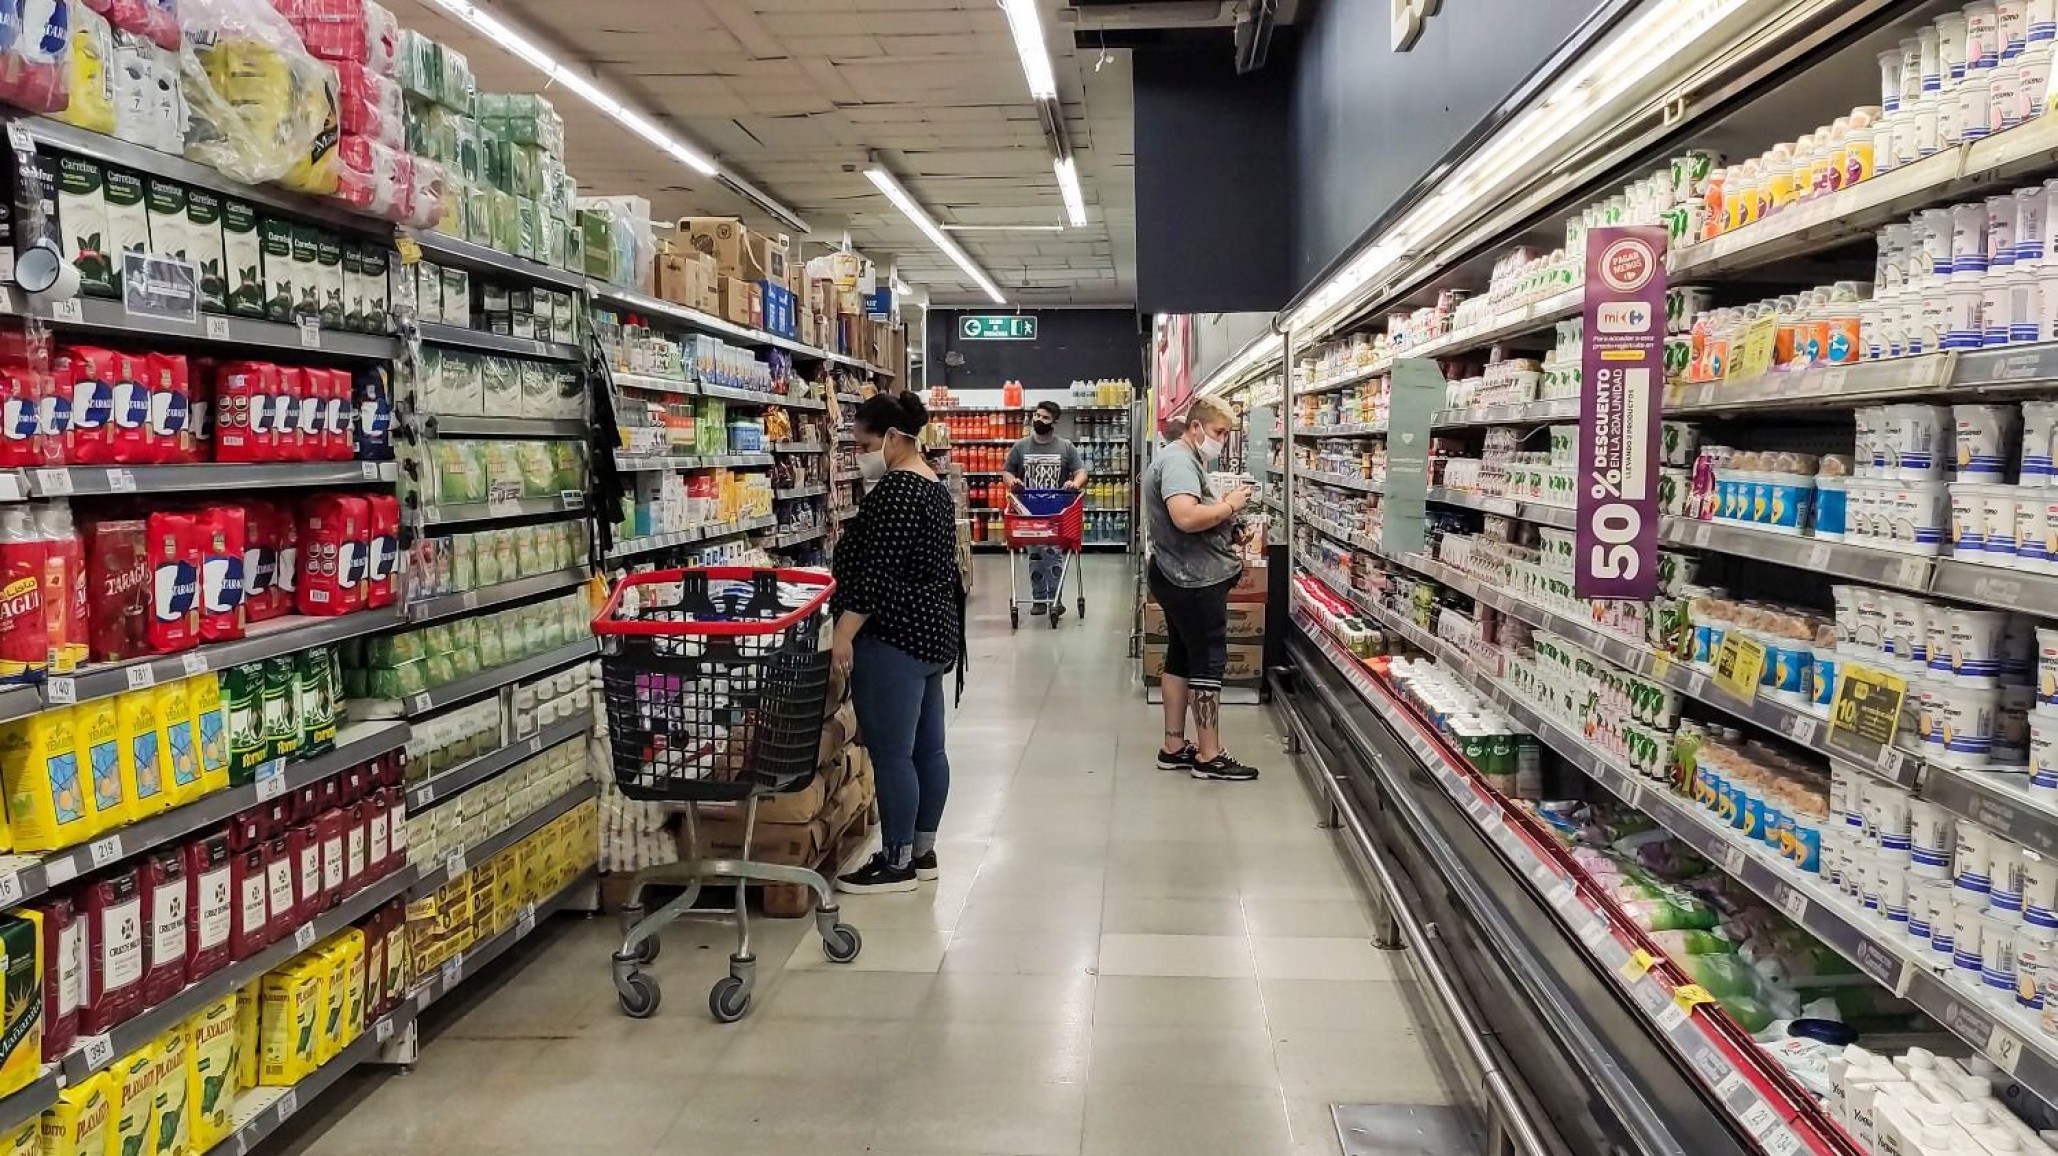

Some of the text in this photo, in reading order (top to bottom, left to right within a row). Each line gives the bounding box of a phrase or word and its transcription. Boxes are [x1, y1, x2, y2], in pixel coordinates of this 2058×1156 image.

[60, 157, 99, 175] Carrefour
[106, 169, 141, 187] Carrefour
[151, 180, 183, 196] Carrefour
[1612, 252, 1639, 266] PAGAR
[1613, 259, 1642, 274] MENOS
[1605, 312, 1619, 324] mi
[1594, 367, 1611, 468] DESCUENTO
[1610, 368, 1623, 468] EN LA 2DA UNIDAD
[1626, 388, 1635, 434] PRODUCTOS
[1625, 440, 1633, 480] LLEVANDO
